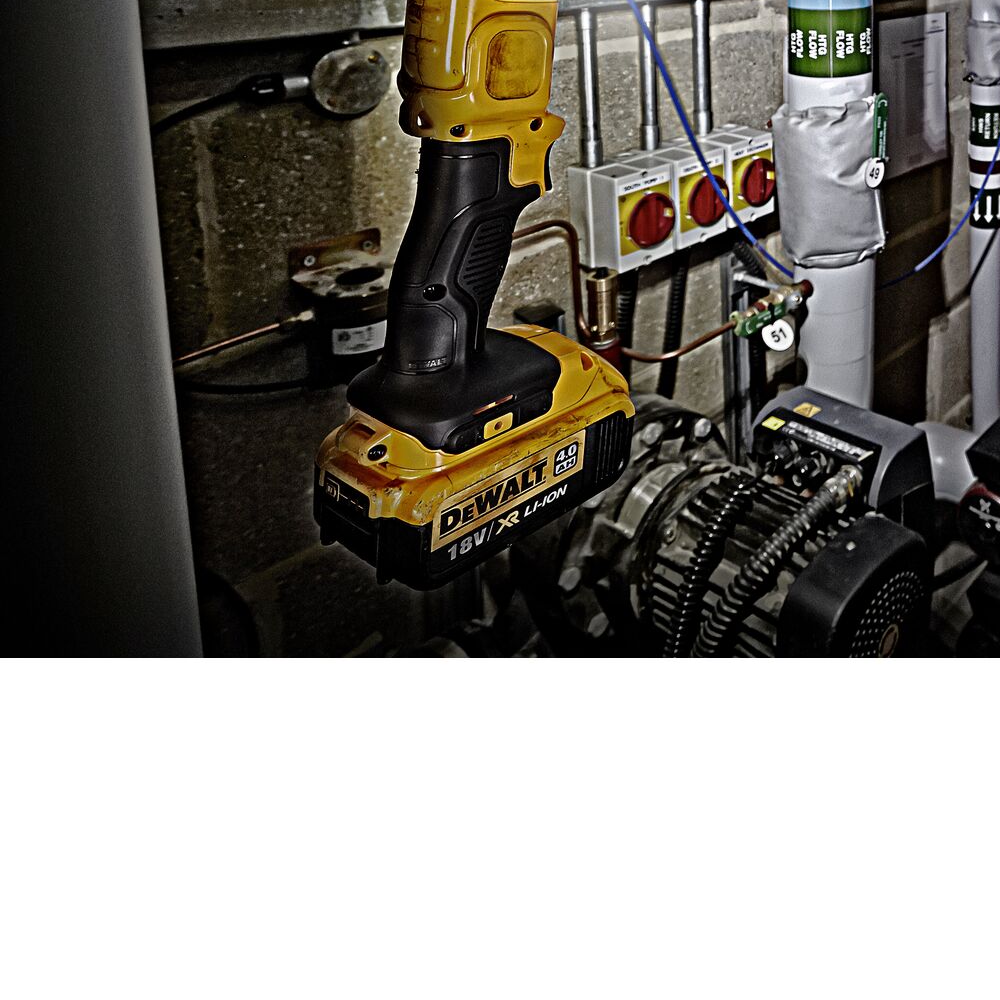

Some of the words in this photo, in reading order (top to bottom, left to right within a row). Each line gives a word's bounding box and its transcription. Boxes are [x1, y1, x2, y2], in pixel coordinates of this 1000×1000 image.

[808, 30, 818, 59] FLOW
[818, 34, 827, 55] HTG
[835, 30, 845, 59] FLOW
[845, 33, 855, 54] HTG
[869, 167, 880, 179] 49
[771, 328, 787, 343] 51
[555, 443, 577, 462] 4.0
[557, 458, 576, 473] AH
[440, 459, 548, 537] DEWALT
[524, 484, 568, 518] LI-ION
